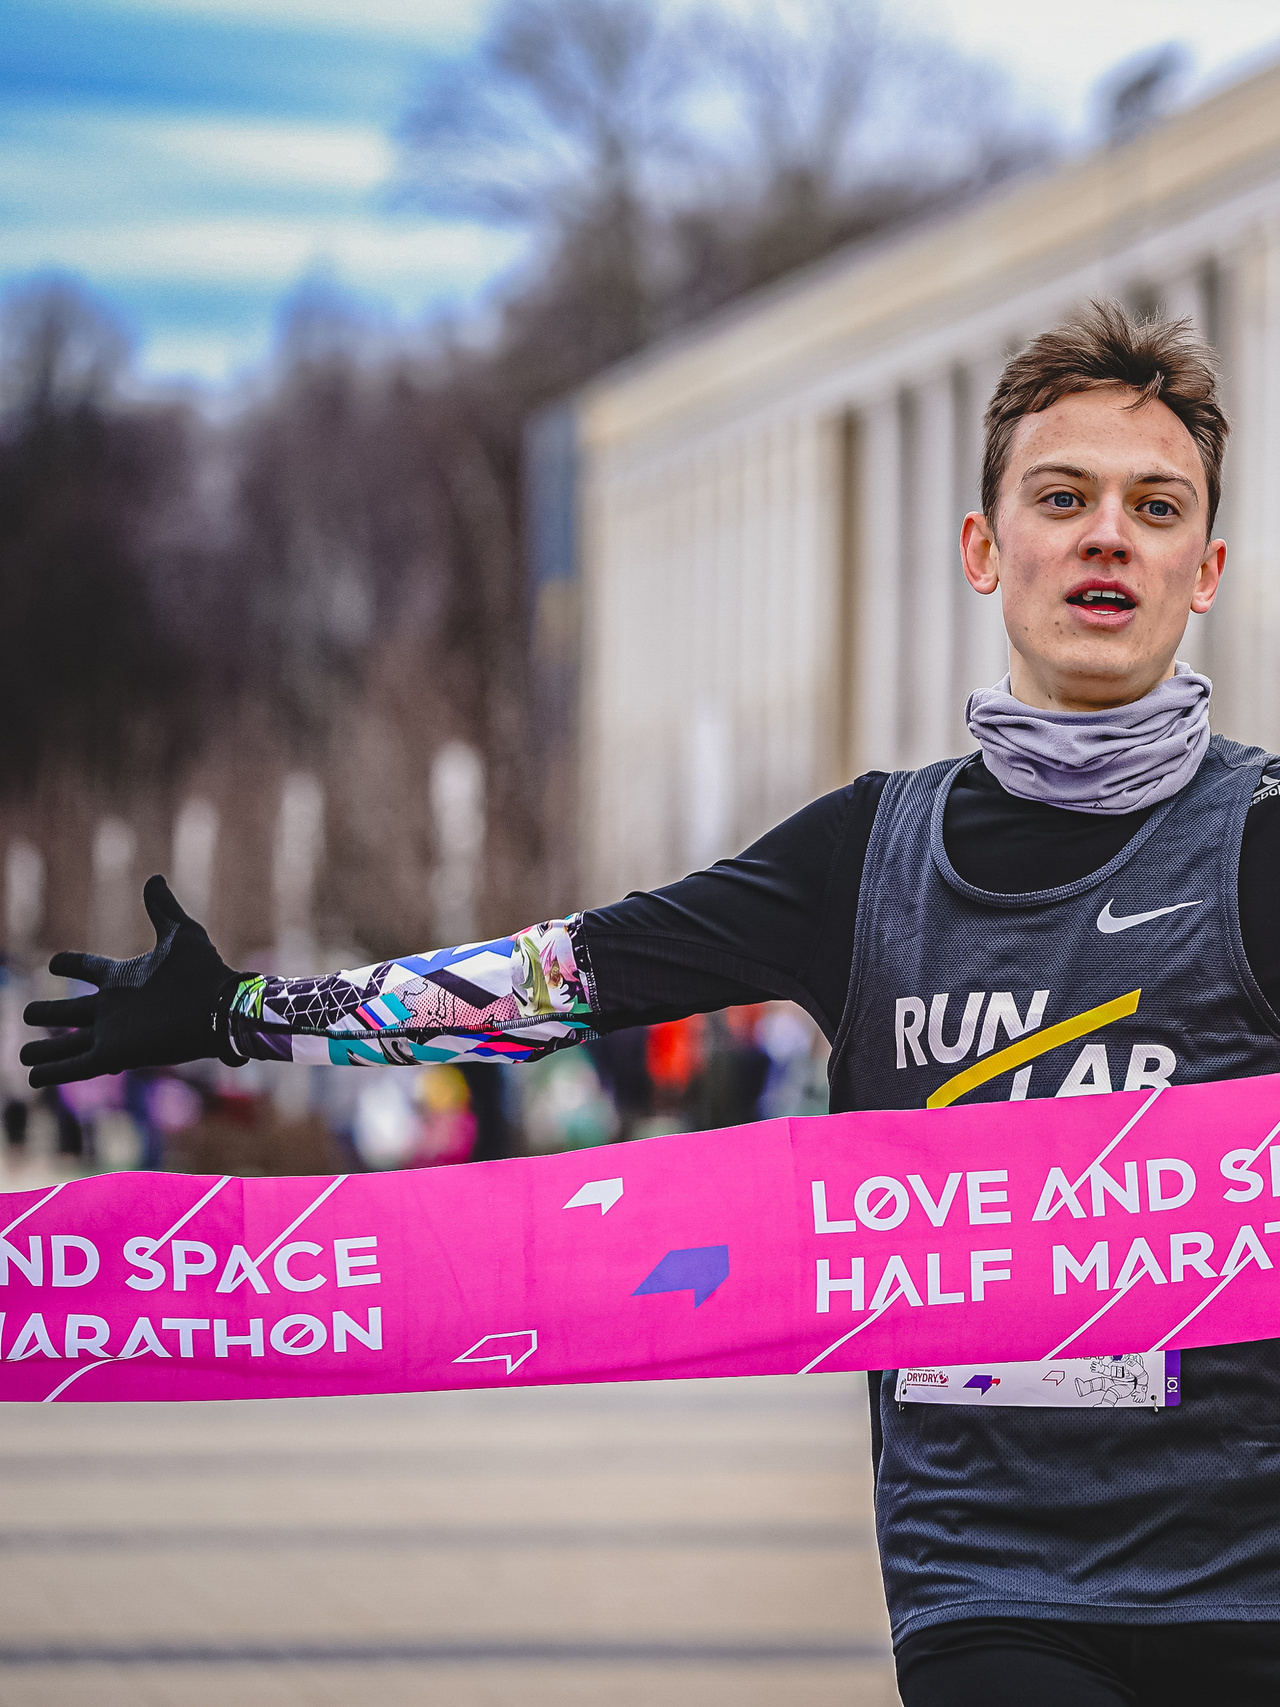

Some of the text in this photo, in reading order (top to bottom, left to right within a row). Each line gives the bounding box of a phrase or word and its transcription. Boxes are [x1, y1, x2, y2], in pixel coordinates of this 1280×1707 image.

[896, 988, 1050, 1070] RUN
[1032, 1157, 1197, 1222] AND
[0, 1234, 382, 1295] ND SPACE
[815, 1248, 1013, 1314] HALF
